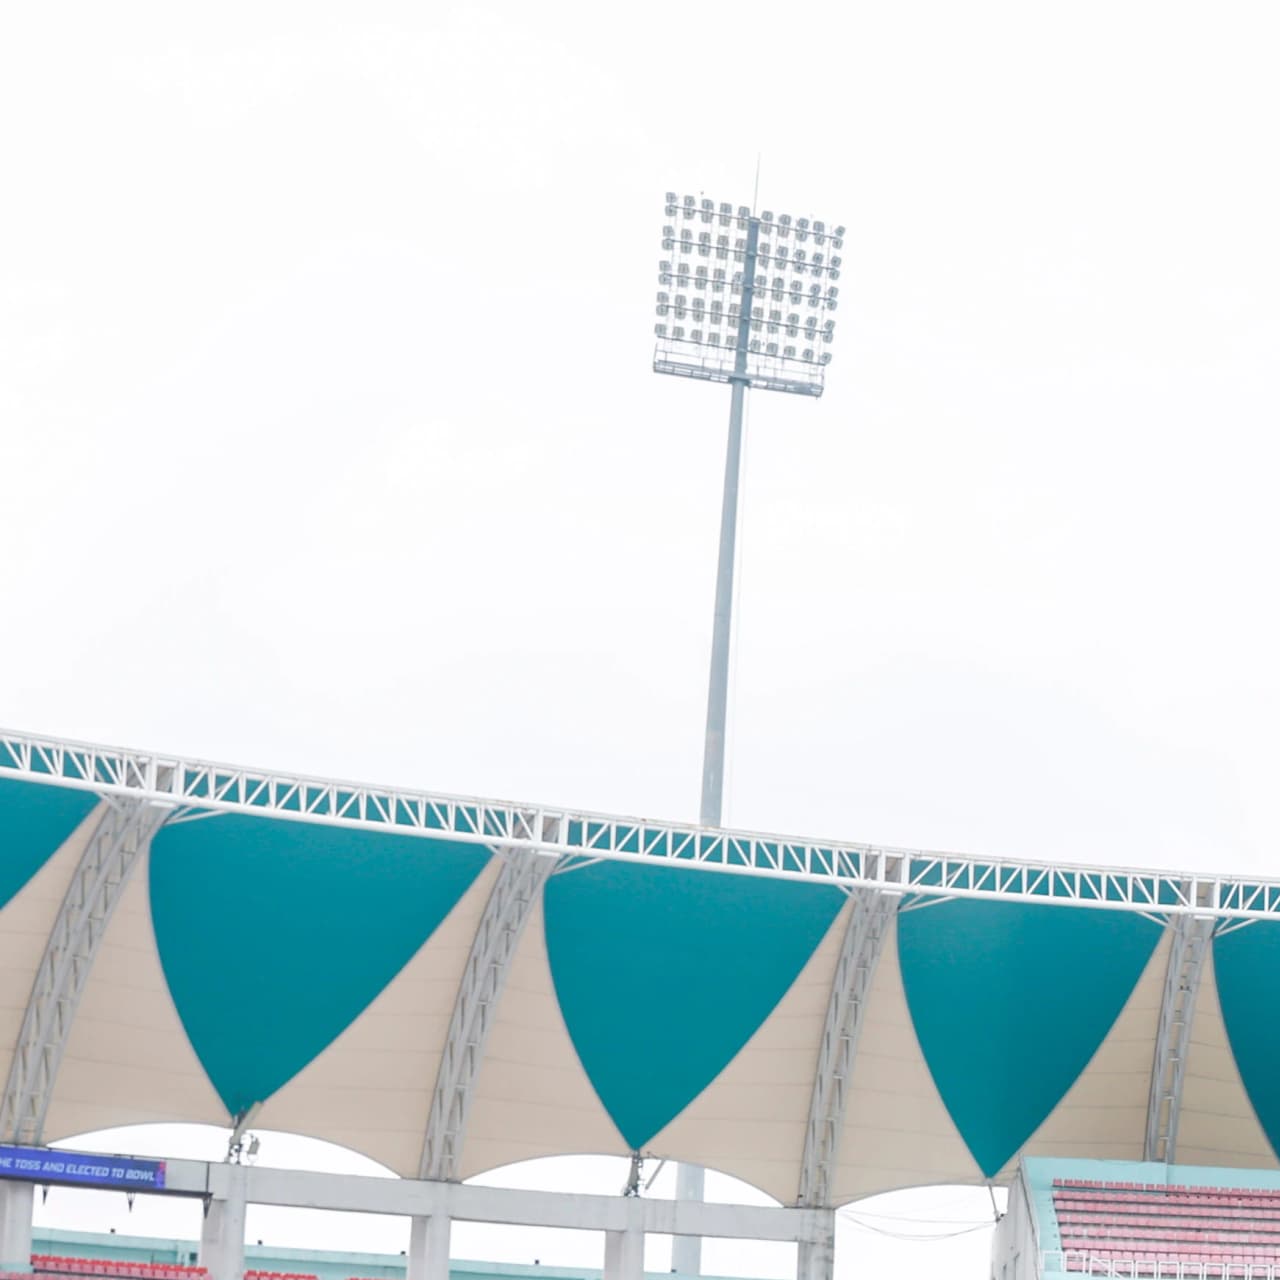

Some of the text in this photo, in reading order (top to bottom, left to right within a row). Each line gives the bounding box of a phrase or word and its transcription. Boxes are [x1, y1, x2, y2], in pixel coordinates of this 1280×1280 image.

[15, 1160, 41, 1171] TOSS
[43, 1162, 64, 1173] AND
[66, 1165, 109, 1177] ELECTED
[112, 1168, 125, 1178] TO
[126, 1170, 155, 1181] BOWL
